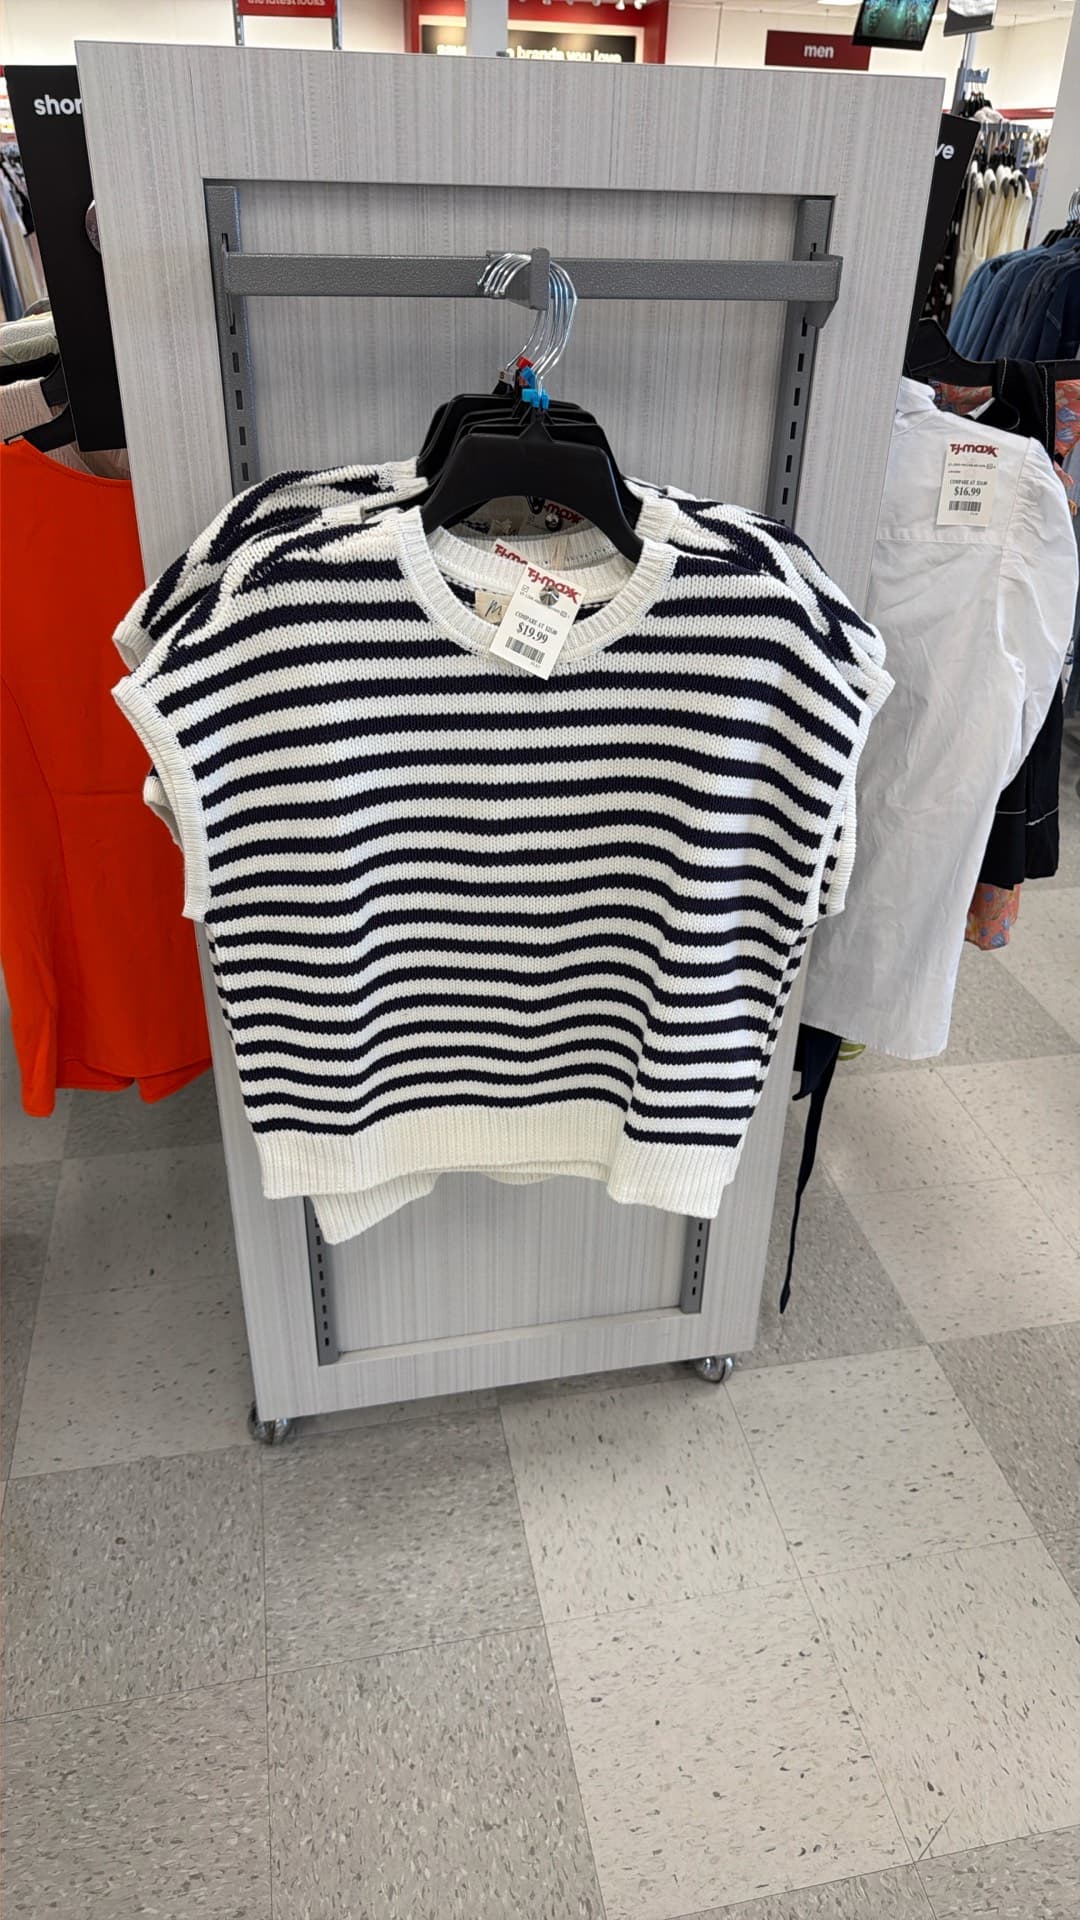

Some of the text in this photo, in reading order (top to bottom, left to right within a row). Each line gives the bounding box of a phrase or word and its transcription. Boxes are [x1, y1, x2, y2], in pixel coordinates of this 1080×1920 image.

[517, 45, 565, 60] brands
[804, 45, 834, 58] men
[953, 486, 981, 496] $16.99
[516, 621, 549, 644] $19.99
